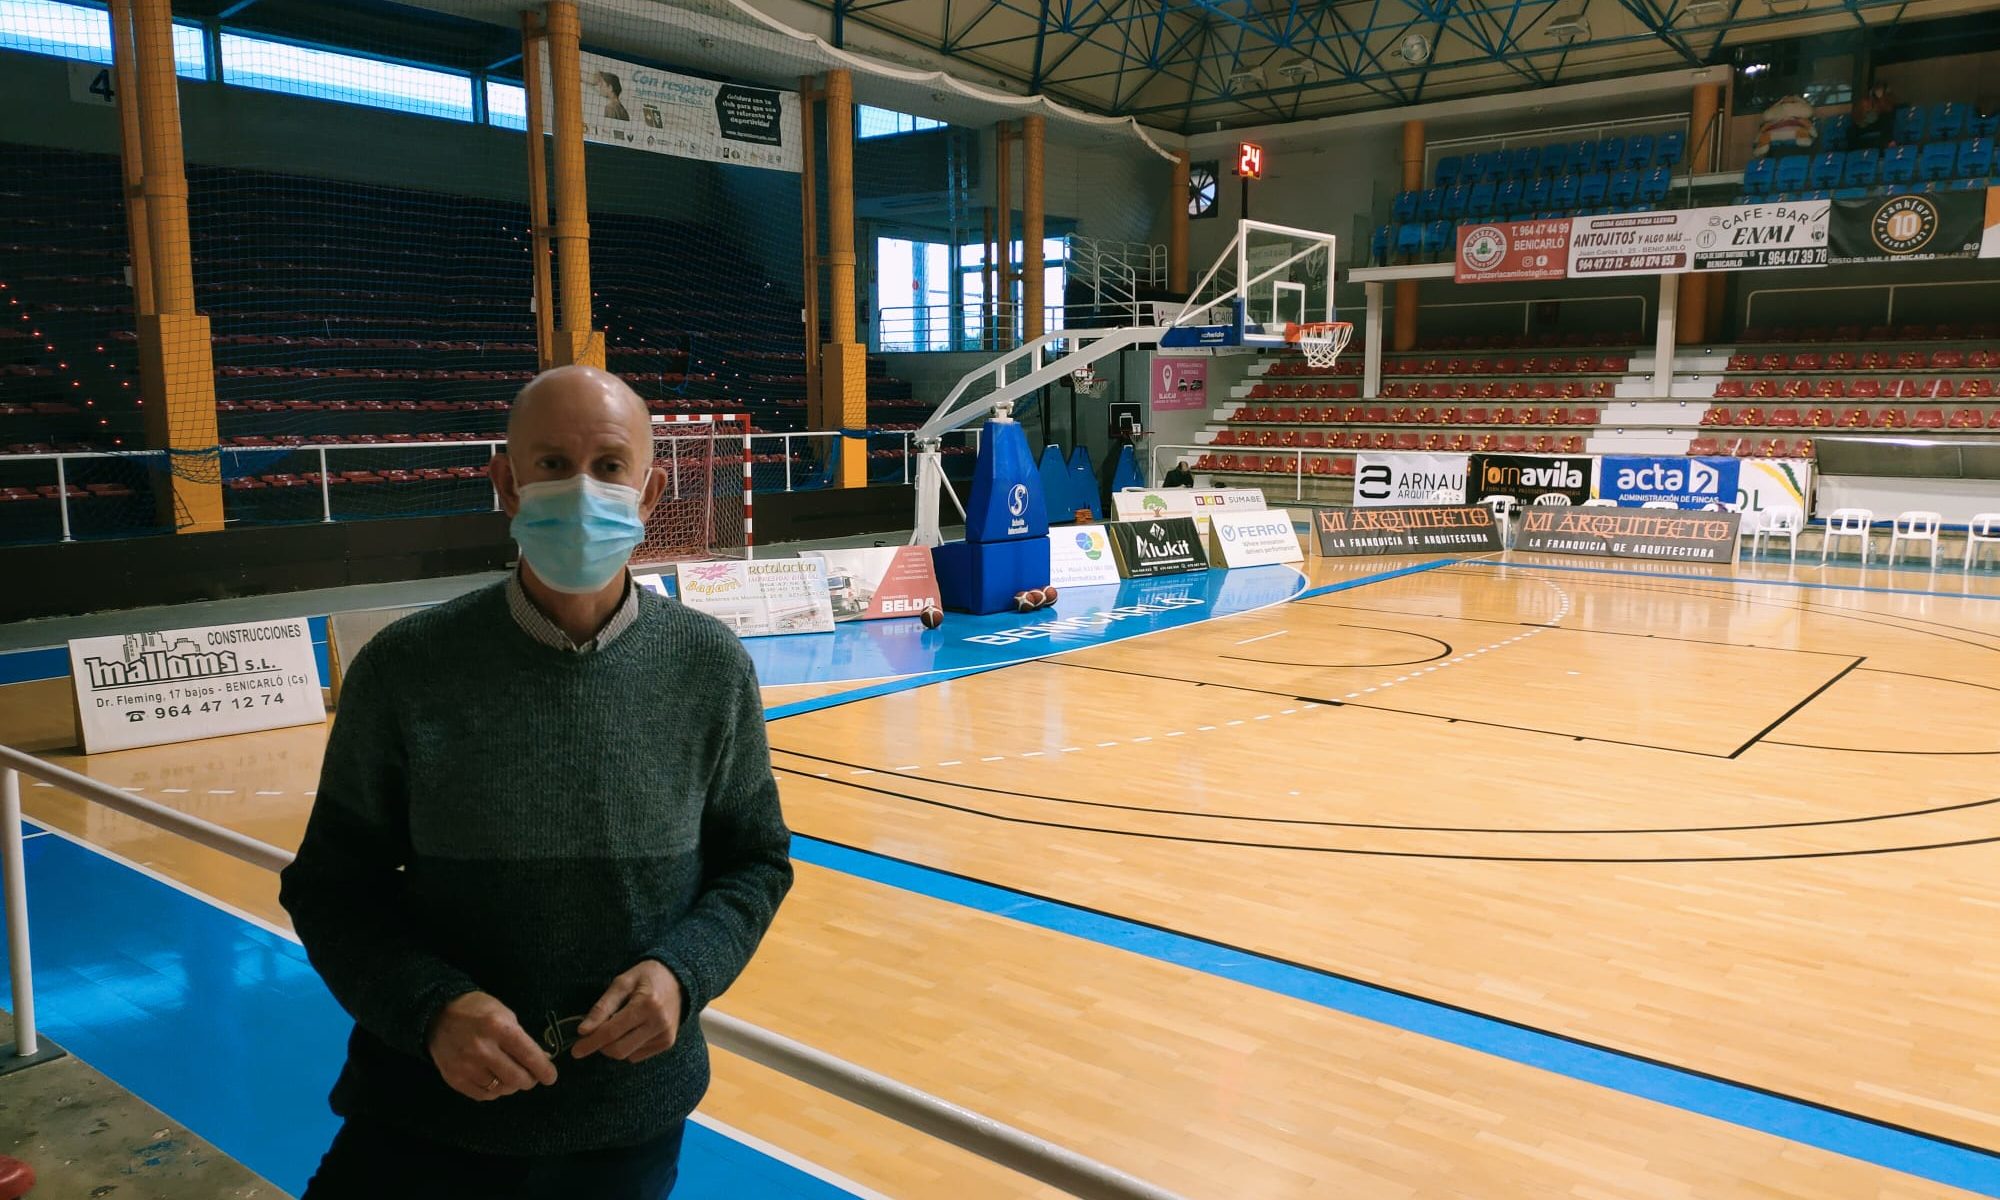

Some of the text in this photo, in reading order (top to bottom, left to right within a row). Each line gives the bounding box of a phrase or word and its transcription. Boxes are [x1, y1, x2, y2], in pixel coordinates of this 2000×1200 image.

[89, 69, 115, 102] 4
[632, 70, 658, 86] Con
[662, 77, 714, 98] respeto
[1241, 144, 1260, 172] 24
[1722, 208, 1762, 230] CAFE
[1776, 207, 1809, 225] BAR
[1877, 199, 1933, 225] frankfurt
[1519, 225, 1534, 236] 964
[1536, 224, 1545, 235] 47
[1547, 223, 1557, 234] 44
[1559, 223, 1569, 233] 99
[1892, 212, 1918, 237] 10
[1573, 231, 1636, 248] ANTOJITOS
[1644, 234, 1664, 244] ALGO
[1732, 225, 1795, 246] ENMI
[1596, 247, 1618, 256] Carlos
[1768, 250, 1786, 265] 964
[1787, 250, 1800, 265] 47
[1801, 249, 1813, 263] 39
[1815, 248, 1827, 263] 78
[1398, 473, 1463, 491] ARNAU
[1617, 463, 1683, 491] acta
[1228, 495, 1263, 504] SUMABE
[1398, 490, 1437, 500] ARQUIT
[1619, 493, 1680, 502] ADMINISTRACIÓN
[1681, 494, 1690, 502] DE
[1739, 488, 1764, 512] OL
[1238, 523, 1288, 538] FERRO
[1319, 507, 1494, 533] MI ARQUITECTO
[1523, 510, 1731, 541] MI ARQUITECTO
[1333, 533, 1489, 548] LA FRANQUICIA DE ARQUITECTURA
[1529, 538, 1715, 559] LA FRANQUICIA DE ARQUITECTURA
[747, 560, 817, 576] Rotulación
[881, 597, 935, 613] BELDA
[207, 623, 301, 647] CONSTRUCCIONES
[245, 658, 276, 672] S.L.
[96, 696, 114, 708] Dr.
[169, 689, 181, 700] 17
[185, 686, 214, 699] bajos
[226, 674, 284, 692] BENICARLÓ
[287, 674, 309, 687] (Cs)
[155, 692, 285, 719] 964 47 12 74
